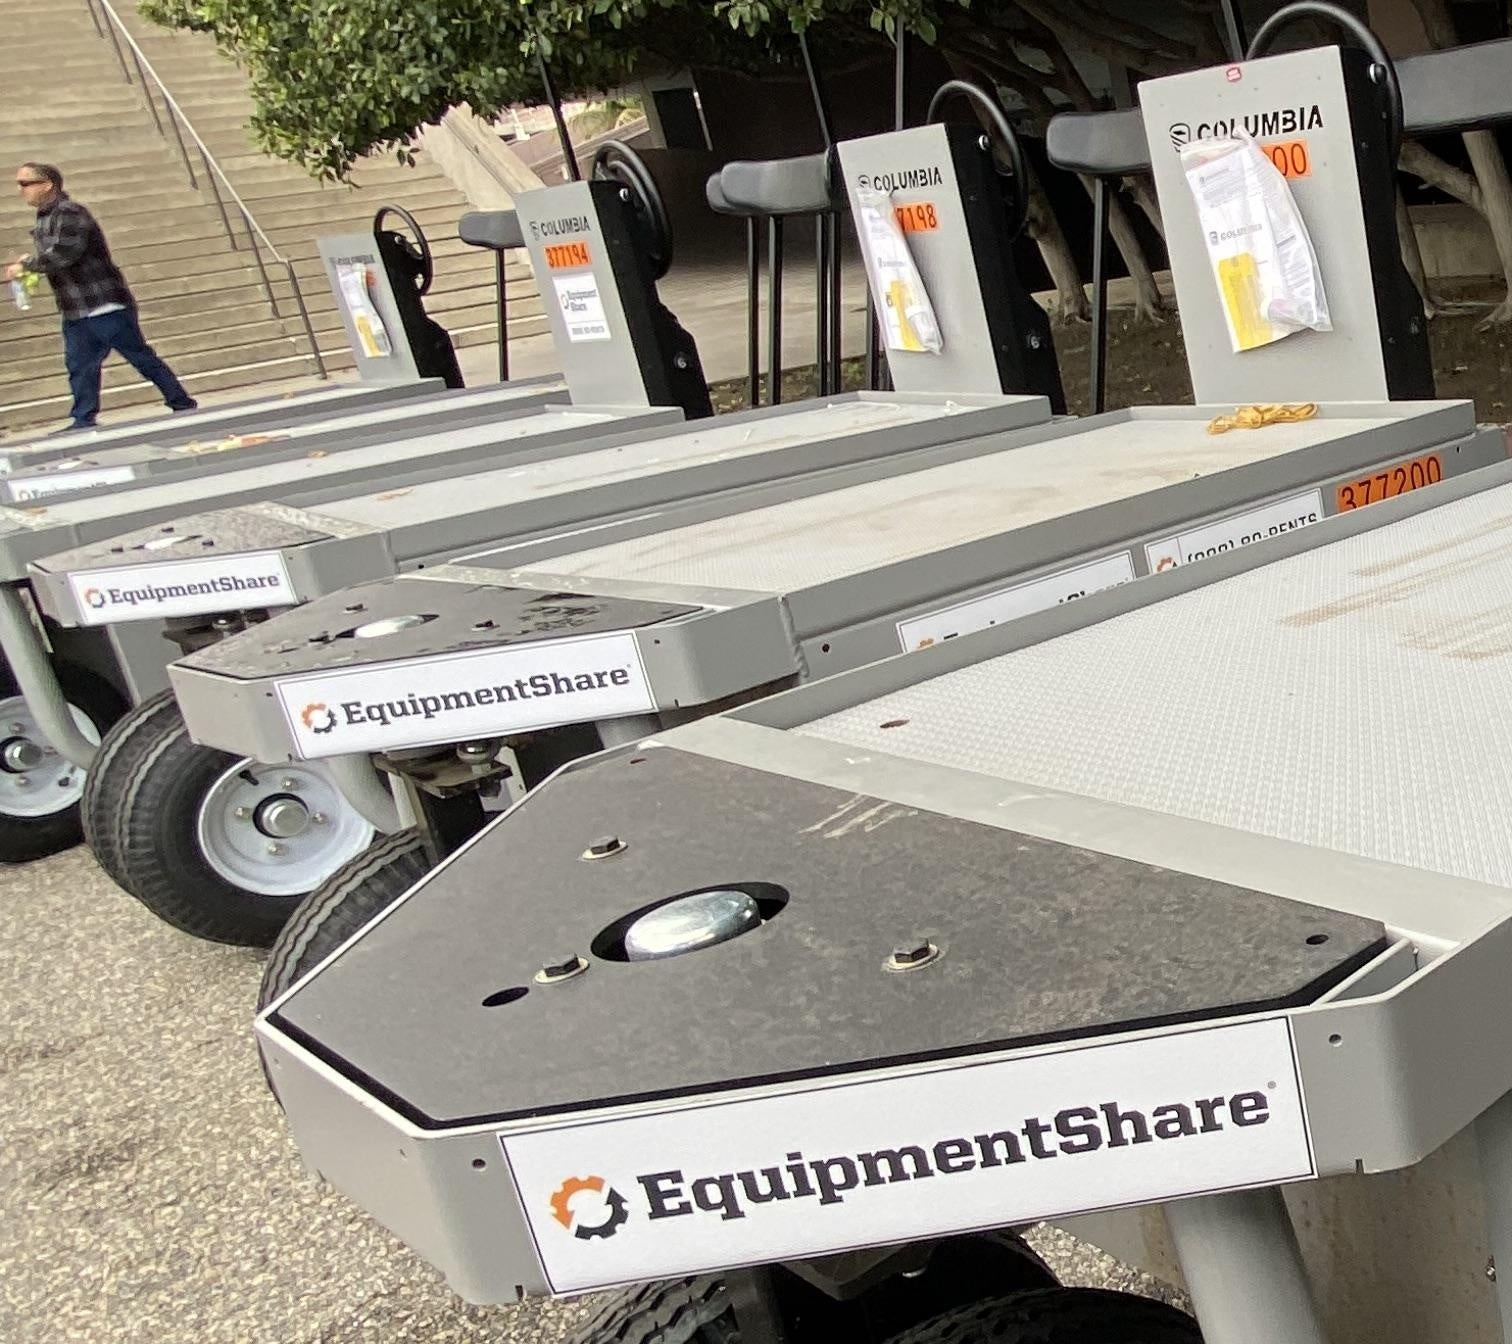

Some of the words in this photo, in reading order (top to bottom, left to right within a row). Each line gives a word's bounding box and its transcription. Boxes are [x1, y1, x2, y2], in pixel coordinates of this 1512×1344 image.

[873, 166, 943, 193] COLUMBIA
[540, 216, 591, 236] COLUMBIA
[108, 573, 280, 606] EquipmentShare
[341, 663, 631, 727] EquipmentShare
[637, 1089, 1271, 1222] EquipmentShare
